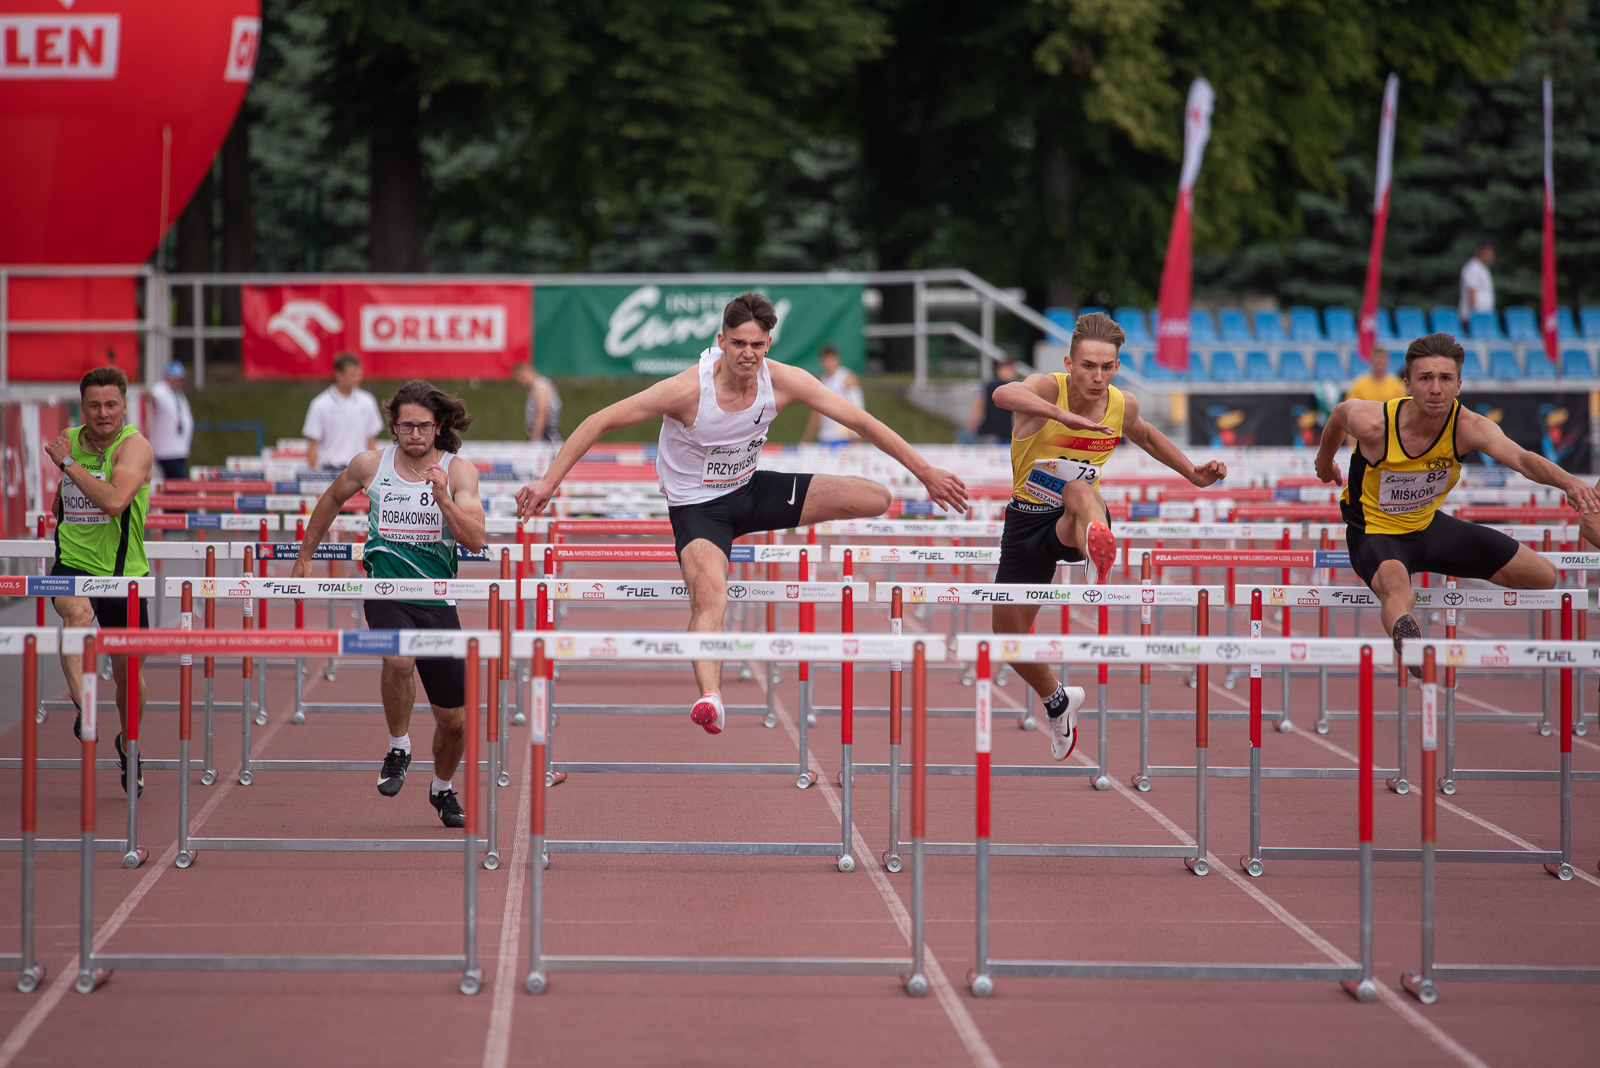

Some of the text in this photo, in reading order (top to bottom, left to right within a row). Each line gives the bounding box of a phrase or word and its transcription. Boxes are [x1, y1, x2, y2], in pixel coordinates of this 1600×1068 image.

[664, 293, 731, 314] INTE
[372, 315, 493, 342] ORLEN
[1076, 466, 1096, 480] 73
[1426, 470, 1447, 483] 82
[1032, 472, 1066, 495] BRZEZ
[1028, 488, 1060, 506] WARSZAWA
[1390, 486, 1436, 501] MIŚKÓW
[63, 496, 97, 509] PACIORE
[420, 492, 436, 507] 87
[382, 510, 440, 526] ROBAKOWSKI
[382, 532, 414, 540] WARSZAWA
[954, 550, 992, 558] TOTALbet
[1560, 556, 1599, 564] TOTALbet
[273, 584, 306, 594] FUEL
[318, 582, 363, 592] TOTALbet
[400, 585, 423, 593] Okęcie
[752, 588, 776, 596] Okęcie
[626, 588, 659, 598] FUEL
[982, 592, 1014, 602] FUEL
[1025, 589, 1070, 600] TOTALbet
[1107, 593, 1130, 601] Okęcie
[1342, 594, 1374, 604] FUEL
[1469, 596, 1492, 604] Okęcie
[644, 644, 684, 654] FUEL
[1090, 646, 1130, 658] FUEL
[1537, 650, 1577, 662] FUEL
